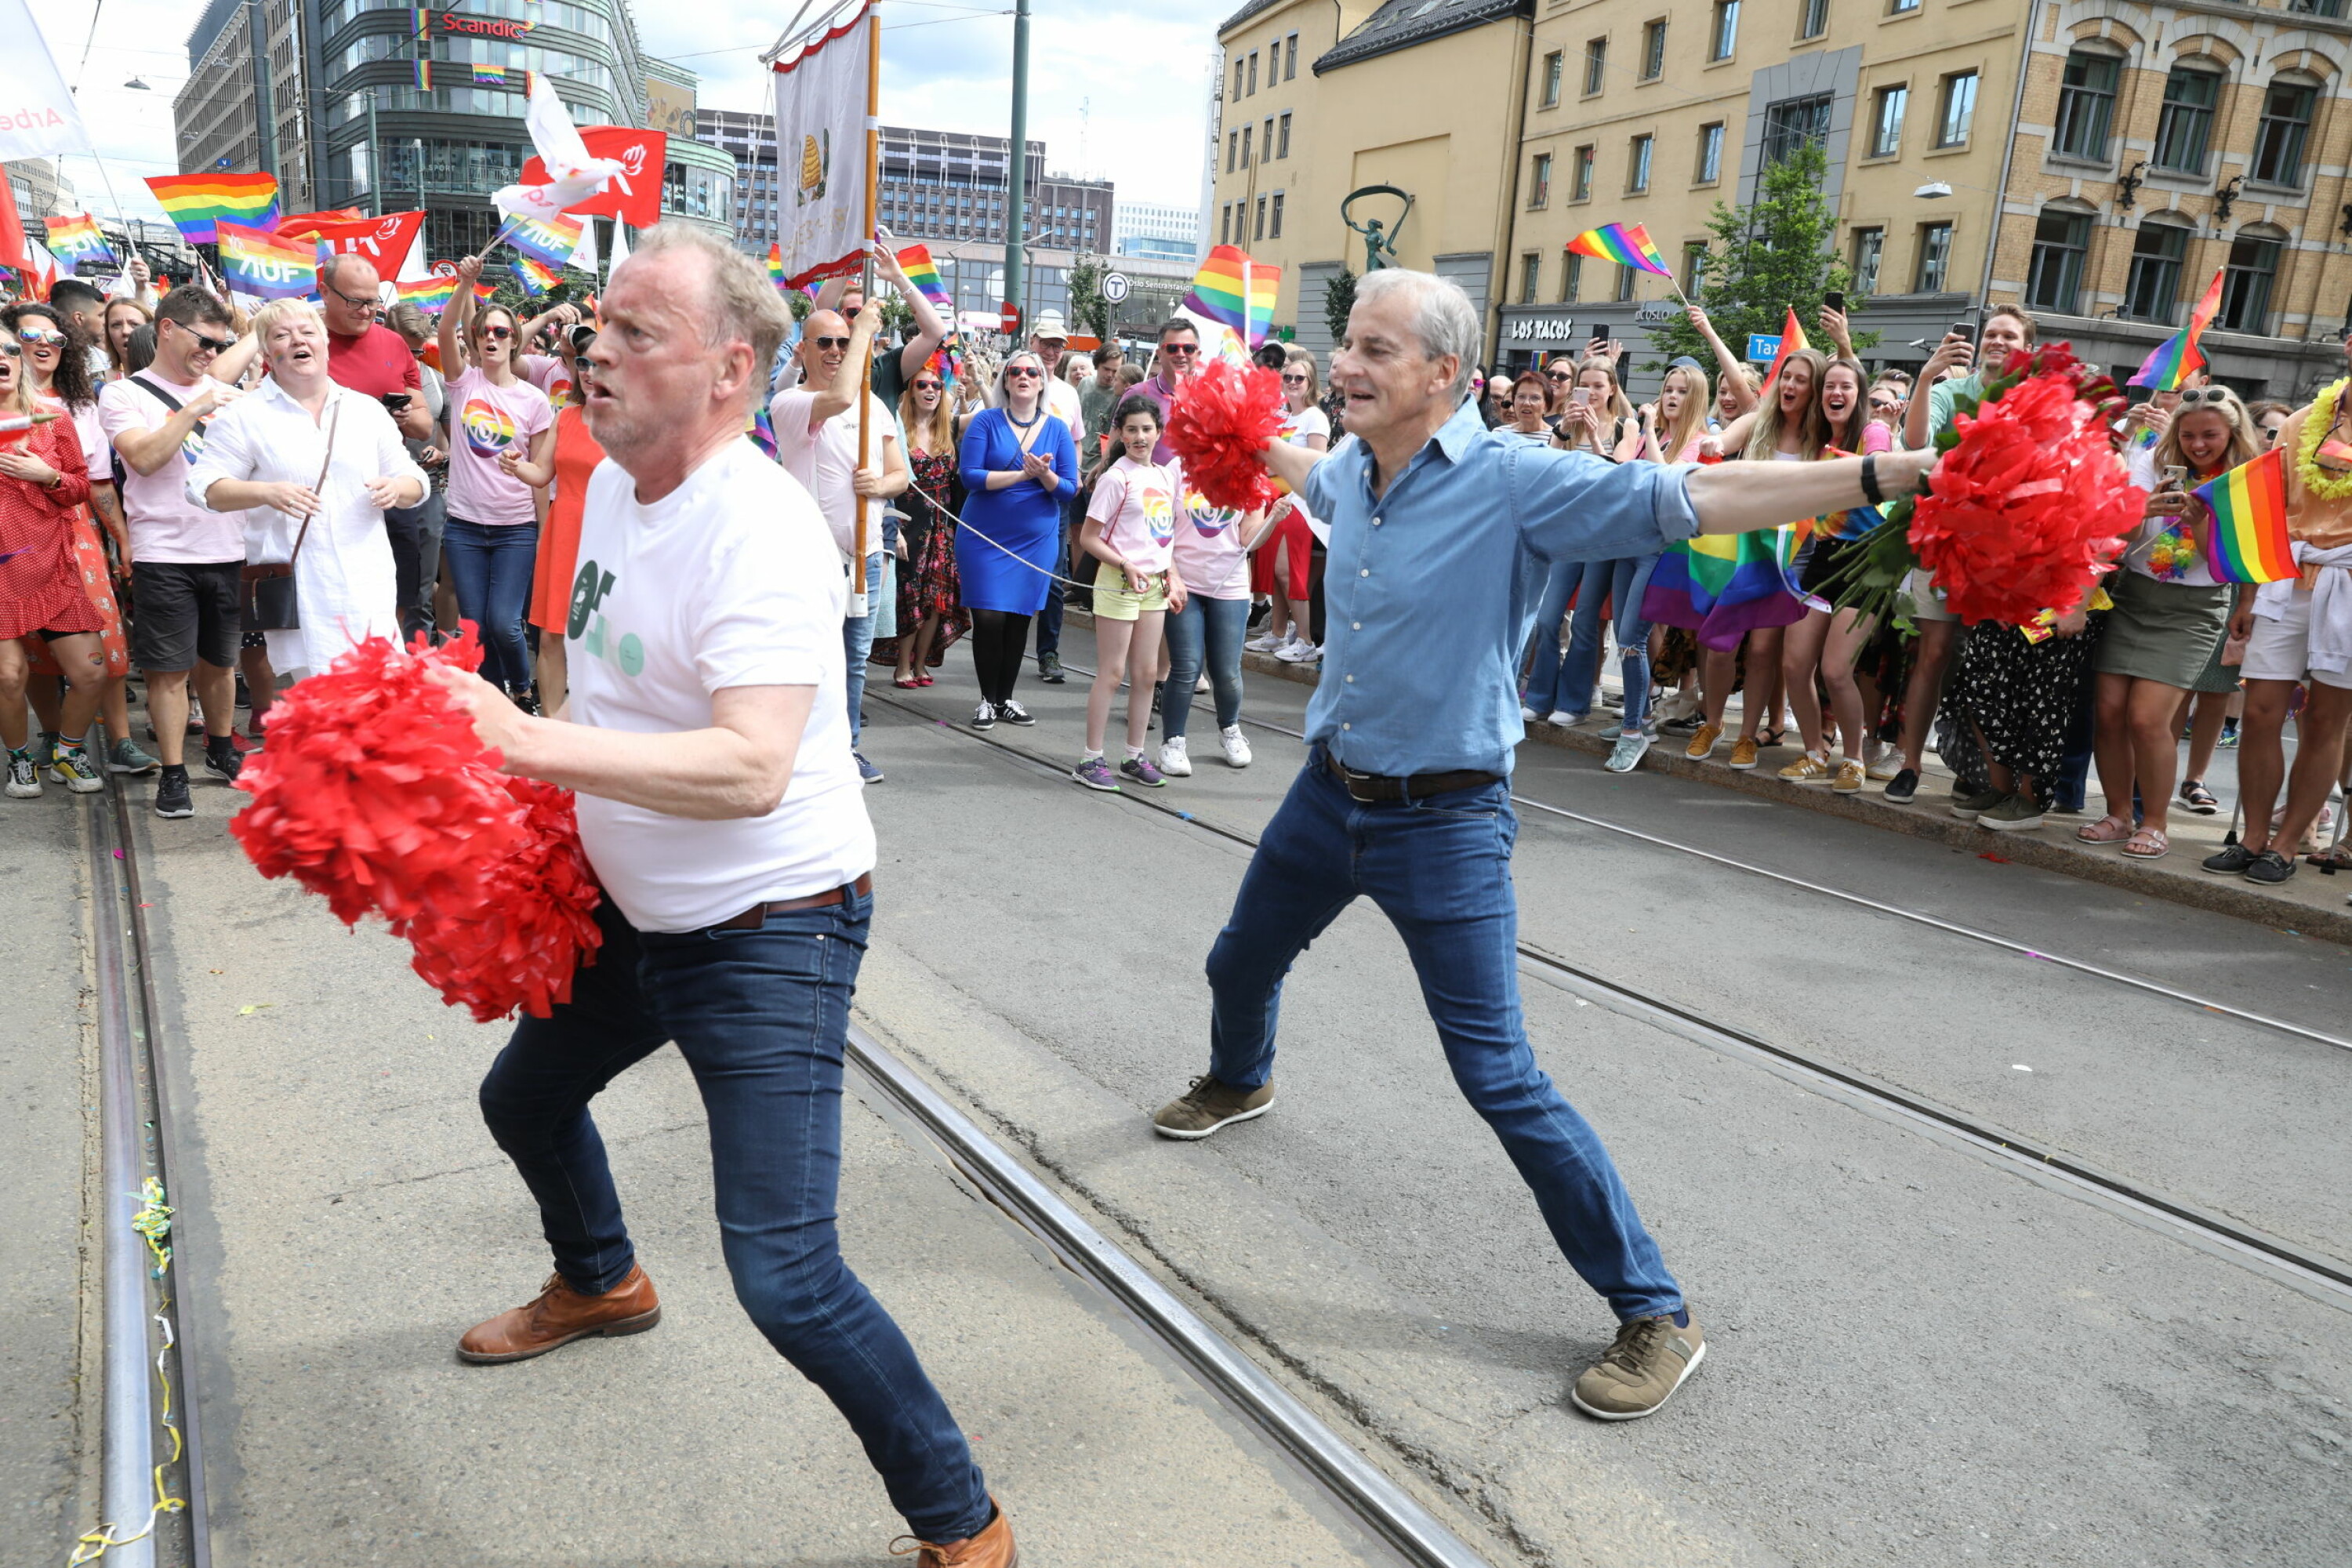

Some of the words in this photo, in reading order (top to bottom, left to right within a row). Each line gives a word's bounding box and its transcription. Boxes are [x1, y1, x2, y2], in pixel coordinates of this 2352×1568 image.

[443, 13, 522, 38] Scandic
[521, 225, 569, 252] AUF
[238, 255, 299, 283] AUF
[1128, 279, 1144, 288] Oslo
[1512, 318, 1534, 339] LOS
[1535, 318, 1573, 339] TACOS
[1755, 339, 1780, 355] Tax
